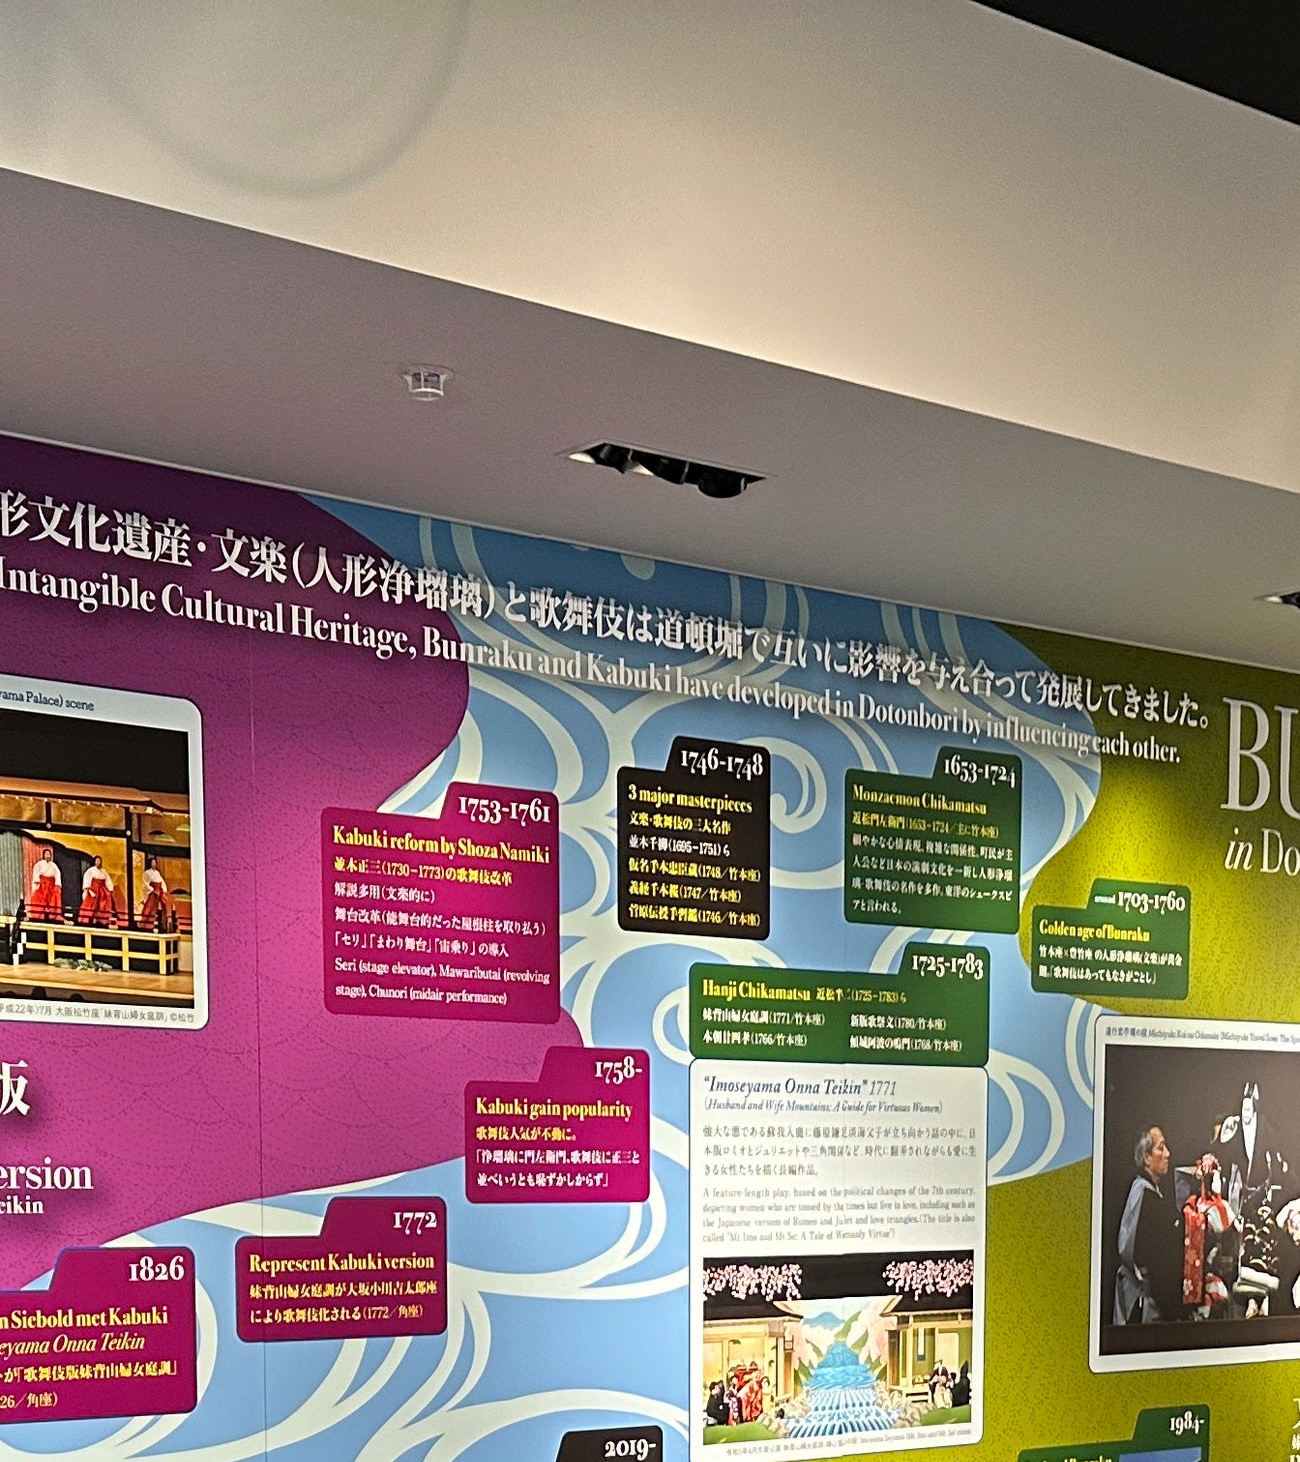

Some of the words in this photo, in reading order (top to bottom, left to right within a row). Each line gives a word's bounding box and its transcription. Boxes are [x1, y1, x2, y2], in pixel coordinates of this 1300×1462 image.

[161, 582, 285, 636] Cultural
[290, 605, 418, 662] Heritage,
[422, 626, 534, 675] Bunraku
[534, 645, 582, 682] and
[586, 654, 672, 694] Kabuki
[675, 671, 722, 703] have
[725, 674, 832, 721] developed
[832, 689, 855, 718] in
[857, 690, 958, 734] Dotonbori
[960, 703, 984, 743] by
[985, 708, 1091, 758] influencing
[1092, 725, 1131, 757] each
[1133, 730, 1181, 764] other.
[25, 690, 64, 708] Palace)
[65, 698, 95, 712] scene
[681, 747, 763, 781] 1746-1748
[944, 754, 1016, 788] 1653-1724
[458, 796, 550, 827] 1753-1761
[628, 783, 637, 800] 3
[639, 786, 675, 808] major
[676, 793, 753, 815] masterpieces
[853, 784, 920, 807] Monzaemon
[921, 792, 987, 815] Chikamatsu
[333, 825, 387, 848] Kabuki
[390, 832, 439, 853] reform
[440, 836, 457, 860] by
[458, 838, 498, 859] Shoza
[499, 841, 550, 864] Namiki
[1224, 828, 1253, 871] in
[1118, 890, 1185, 915] 1703-1760
[1039, 919, 1076, 936] Golden
[1077, 926, 1095, 942] age
[1096, 922, 1108, 939] of
[1108, 925, 1150, 942] Bunraku
[912, 952, 983, 980] 1725-1783
[703, 979, 736, 1002] Hanji
[738, 981, 811, 1001] Chikamatsu
[595, 1056, 642, 1084] 1758-
[785, 1078, 820, 1094] Onna
[870, 1080, 897, 1096] 1771
[476, 1097, 528, 1115] Kabuki
[530, 1099, 560, 1120] gain
[562, 1100, 632, 1122] popularity
[393, 1212, 437, 1235] 1772
[129, 1255, 185, 1282] 1826
[250, 1254, 326, 1277] Represent
[328, 1252, 382, 1270] Kabuki
[384, 1251, 435, 1270] version
[11, 1308, 73, 1329] Siebold
[76, 1311, 107, 1328] met
[108, 1306, 167, 1326] Kabuki
[53, 1334, 96, 1353] Onna
[101, 1332, 145, 1350] Teikin
[1169, 1411, 1205, 1435] 1984-
[605, 1439, 657, 1462] 2019-
